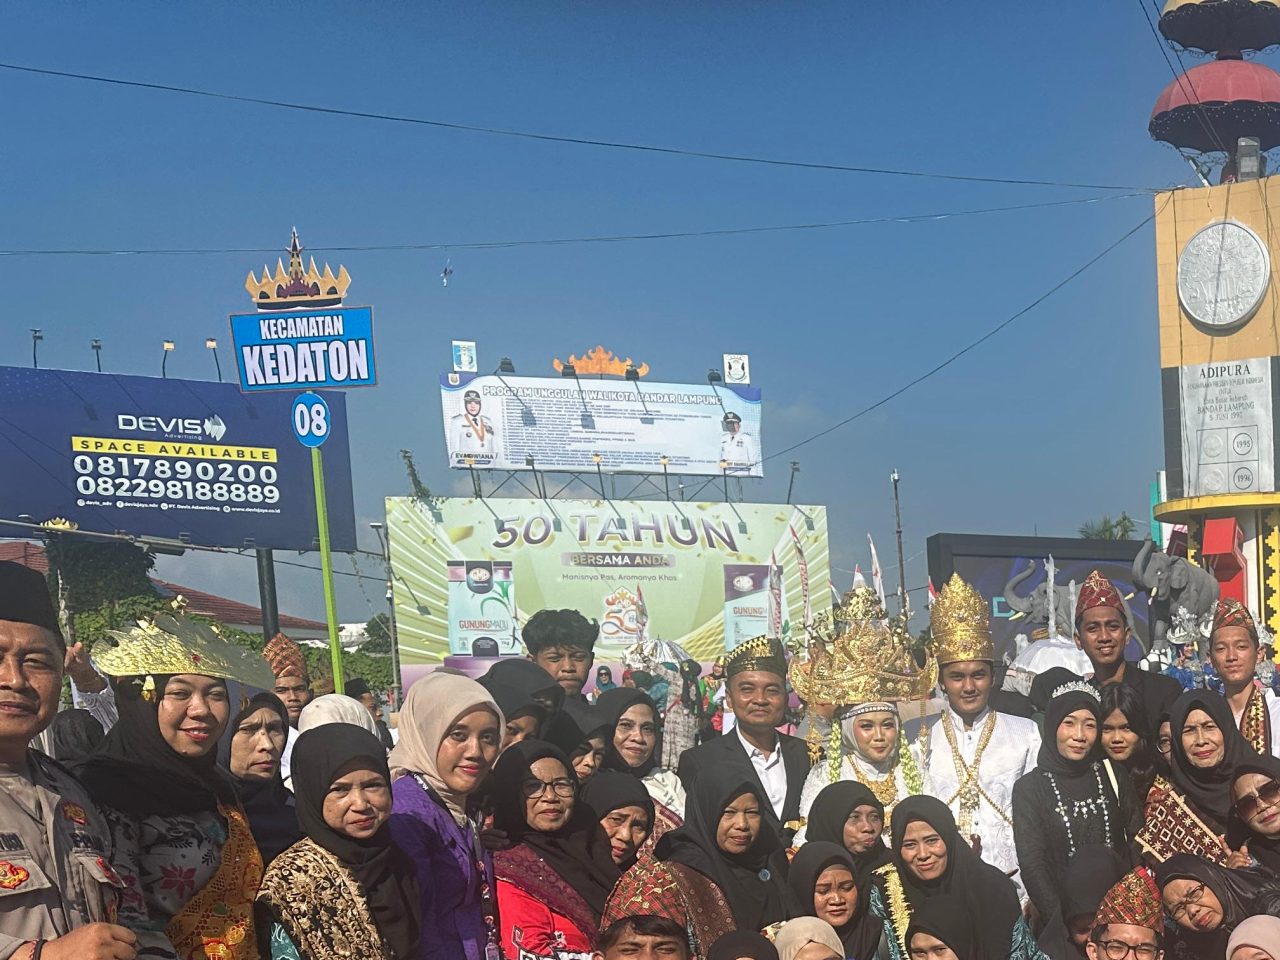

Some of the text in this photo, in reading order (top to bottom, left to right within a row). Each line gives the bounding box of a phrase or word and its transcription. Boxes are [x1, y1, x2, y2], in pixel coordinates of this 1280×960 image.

[259, 315, 344, 340] KECAMATAN
[242, 339, 369, 385] KEDATON
[1199, 364, 1251, 379] ADIPURA
[482, 386, 722, 405] PROGRAM UNGGULAN WALIKOTA BANDAR LAMPUNG
[1197, 401, 1255, 415] BANDAR LAMPUNG
[117, 414, 202, 434] DEVIS
[294, 403, 327, 437] 08
[1214, 413, 1229, 421] JUNI
[164, 433, 202, 441] Advertising
[1236, 440, 1251, 448] 1995
[80, 440, 270, 460] SPACE AVAILABLE
[73, 455, 278, 483] 0817890200
[1237, 474, 1252, 482] 1996
[76, 475, 280, 503] 082298188889
[492, 513, 739, 552] 50 TAHUN
[572, 554, 669, 566] BERSAMA ANDA
[562, 573, 598, 581] Manisnya
[618, 574, 657, 582] Aromanya
[658, 574, 677, 582] Khas
[458, 620, 509, 629] GUNUNGMADU
